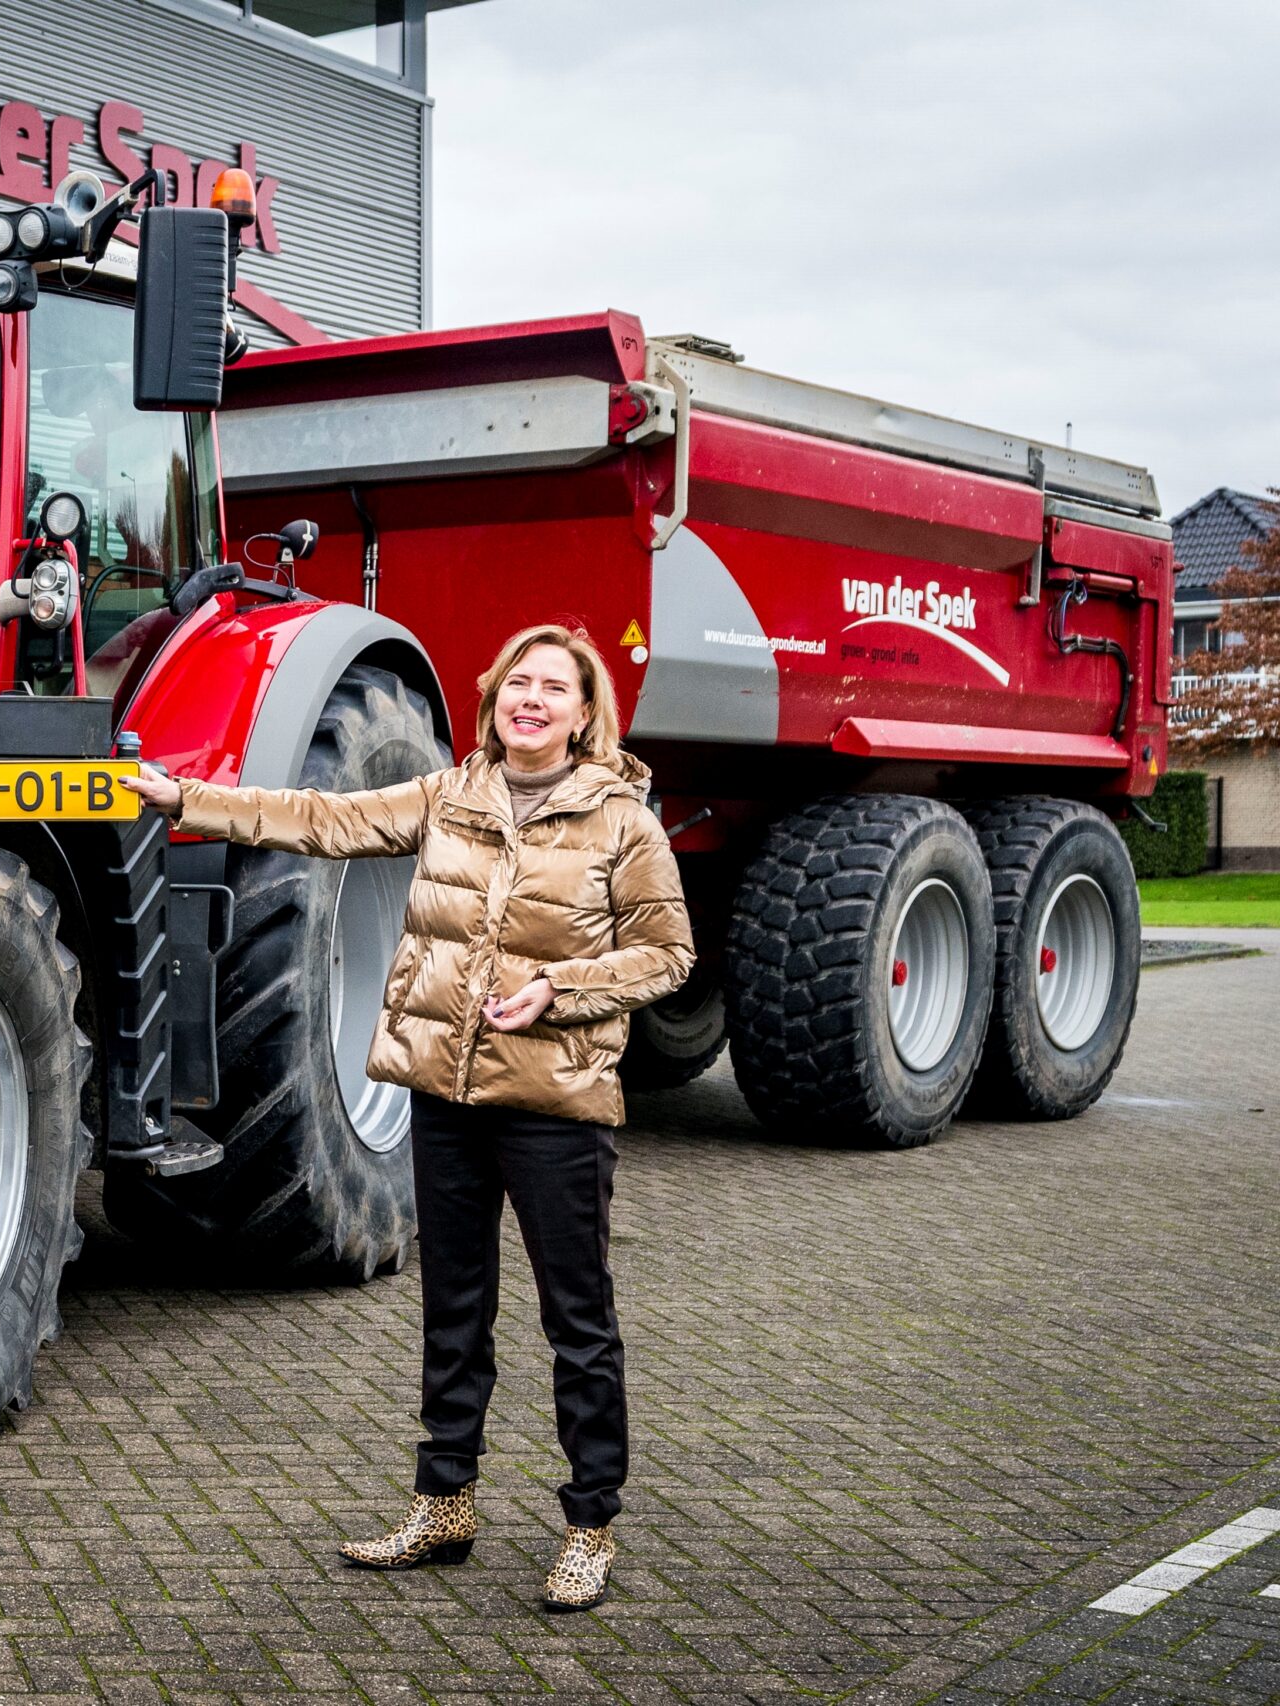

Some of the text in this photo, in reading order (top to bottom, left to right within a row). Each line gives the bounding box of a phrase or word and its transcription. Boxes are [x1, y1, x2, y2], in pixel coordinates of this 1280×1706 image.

[841, 575, 977, 630] van der Spek
[704, 628, 826, 655] www.duurzaam-grondverzet.nl
[870, 646, 897, 664] grond
